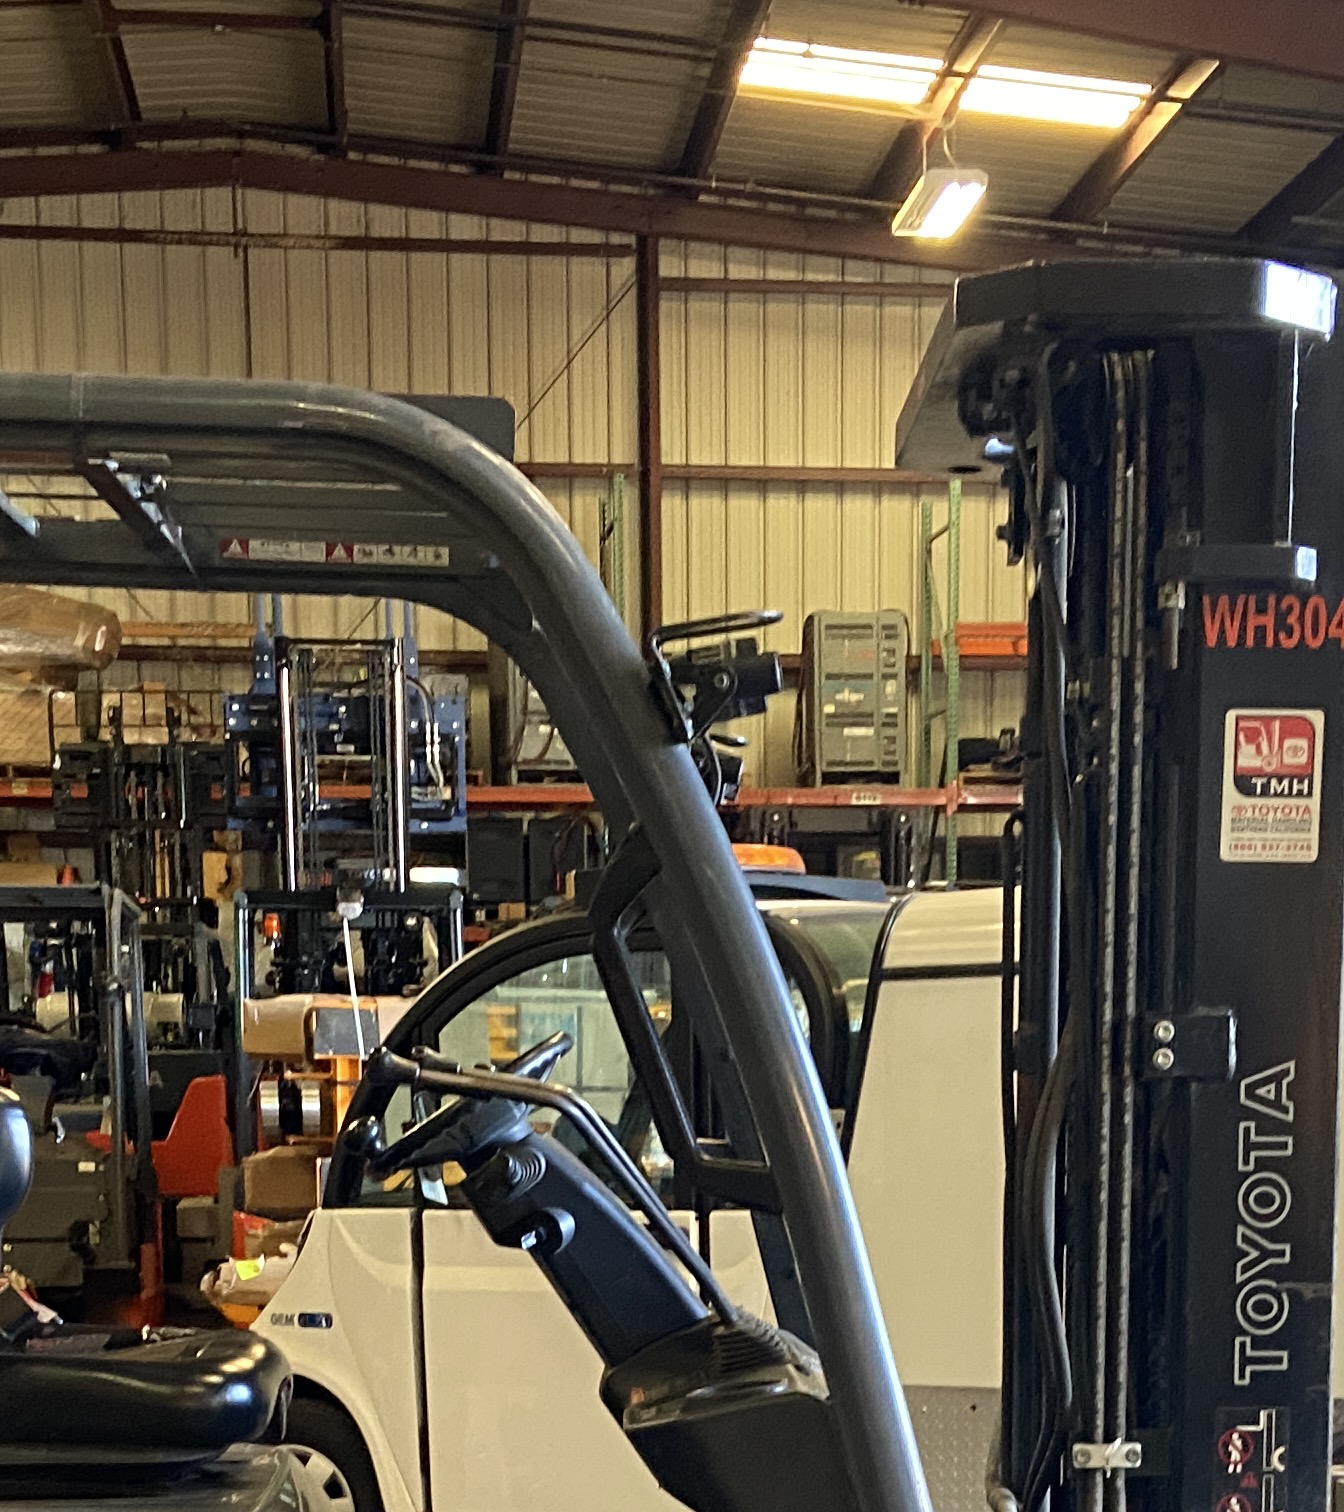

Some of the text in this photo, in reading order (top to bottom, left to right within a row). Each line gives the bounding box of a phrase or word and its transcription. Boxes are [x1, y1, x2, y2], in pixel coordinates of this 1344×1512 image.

[1251, 777, 1309, 796] TMH
[1250, 804, 1312, 817] TOYOTA
[1233, 1059, 1296, 1387] TOYOTA
